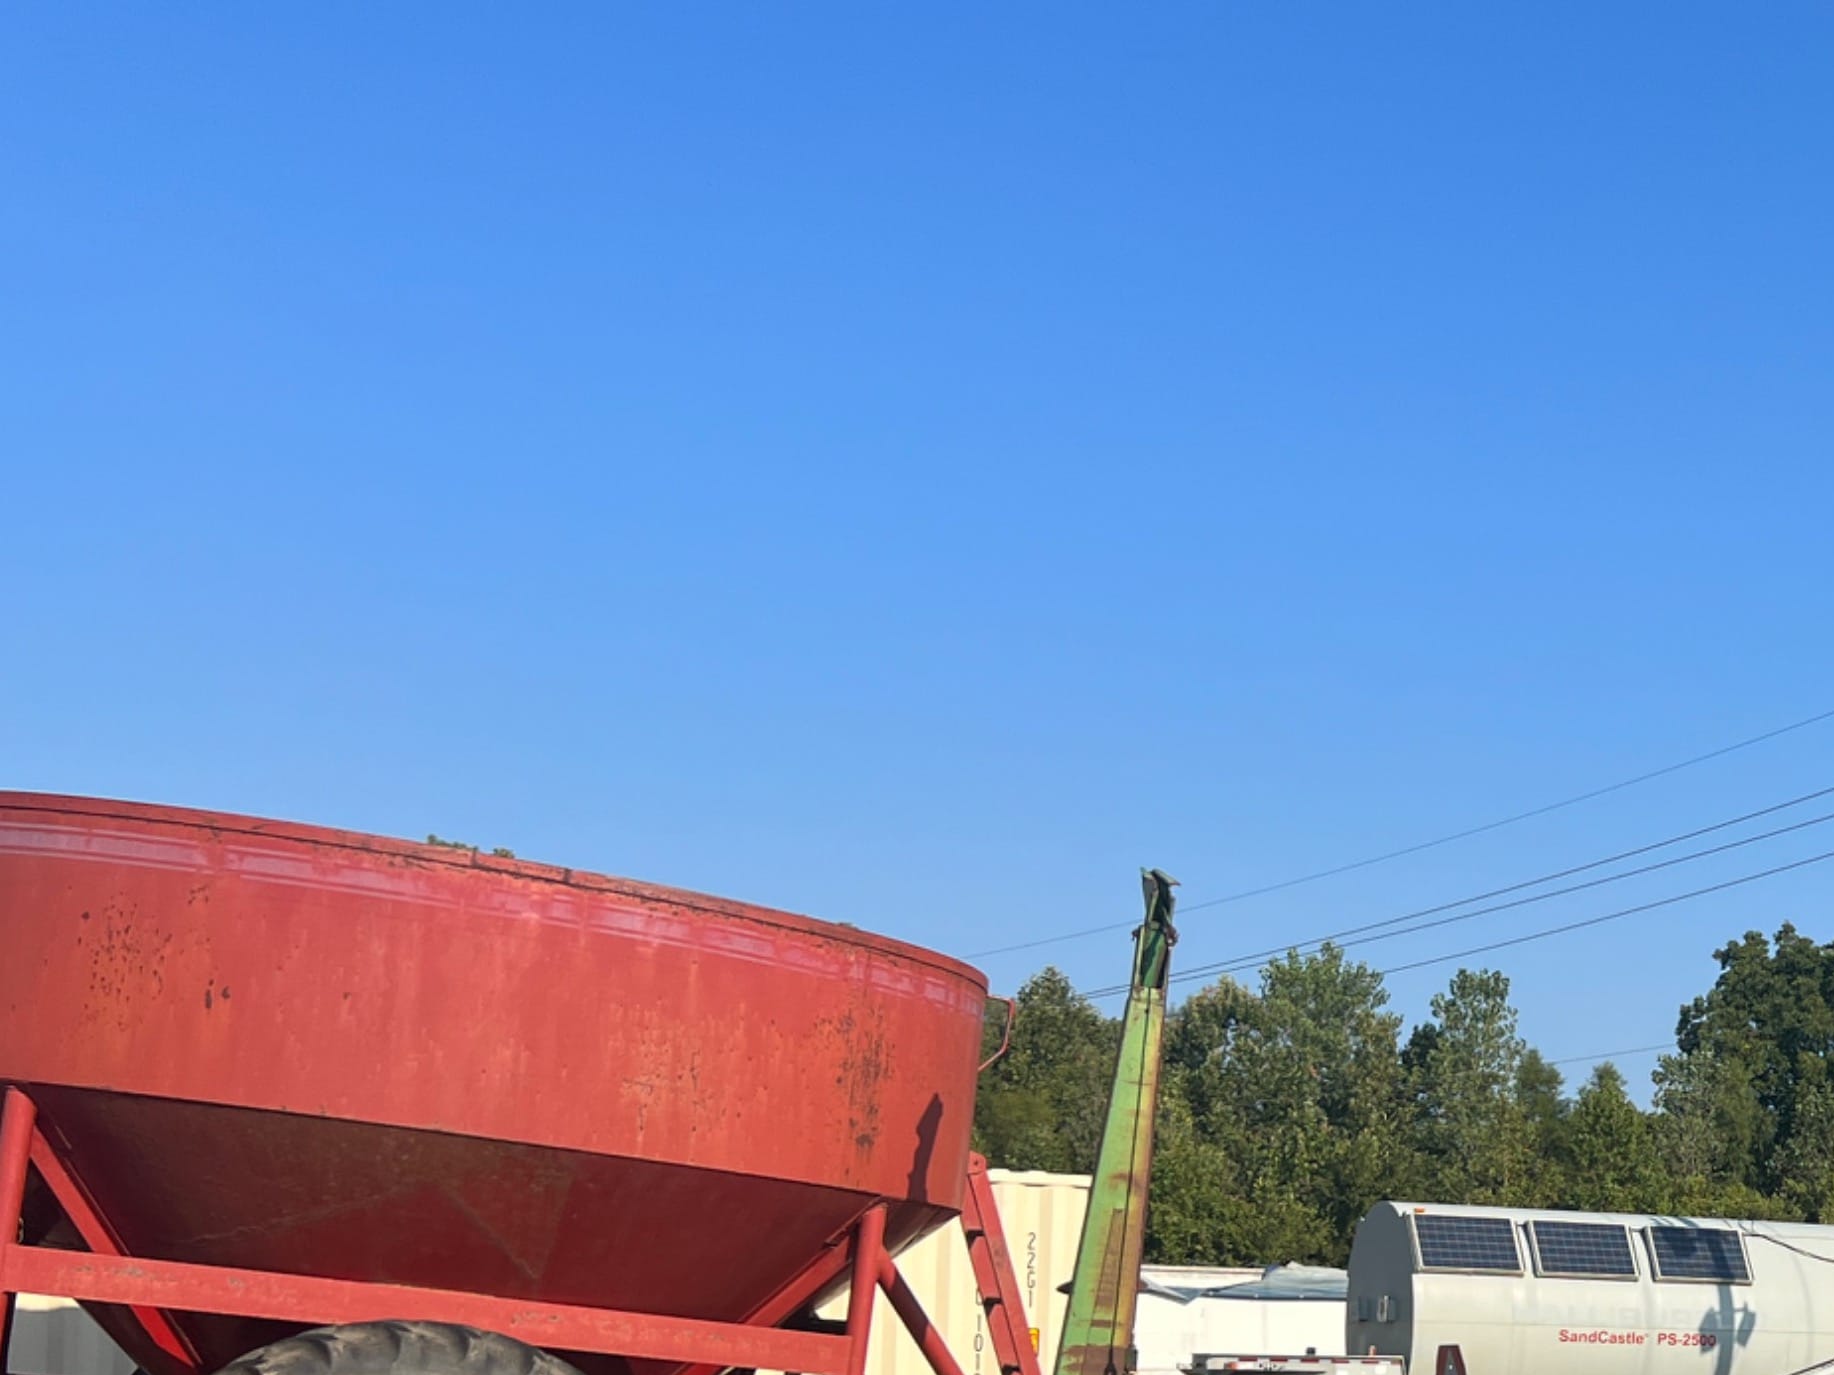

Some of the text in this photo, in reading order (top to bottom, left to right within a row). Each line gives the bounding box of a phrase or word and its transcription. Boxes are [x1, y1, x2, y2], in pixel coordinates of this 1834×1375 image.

[1027, 1231, 1036, 1308] 22G1
[1558, 1329, 1718, 1347] SandCastle PS-2500
